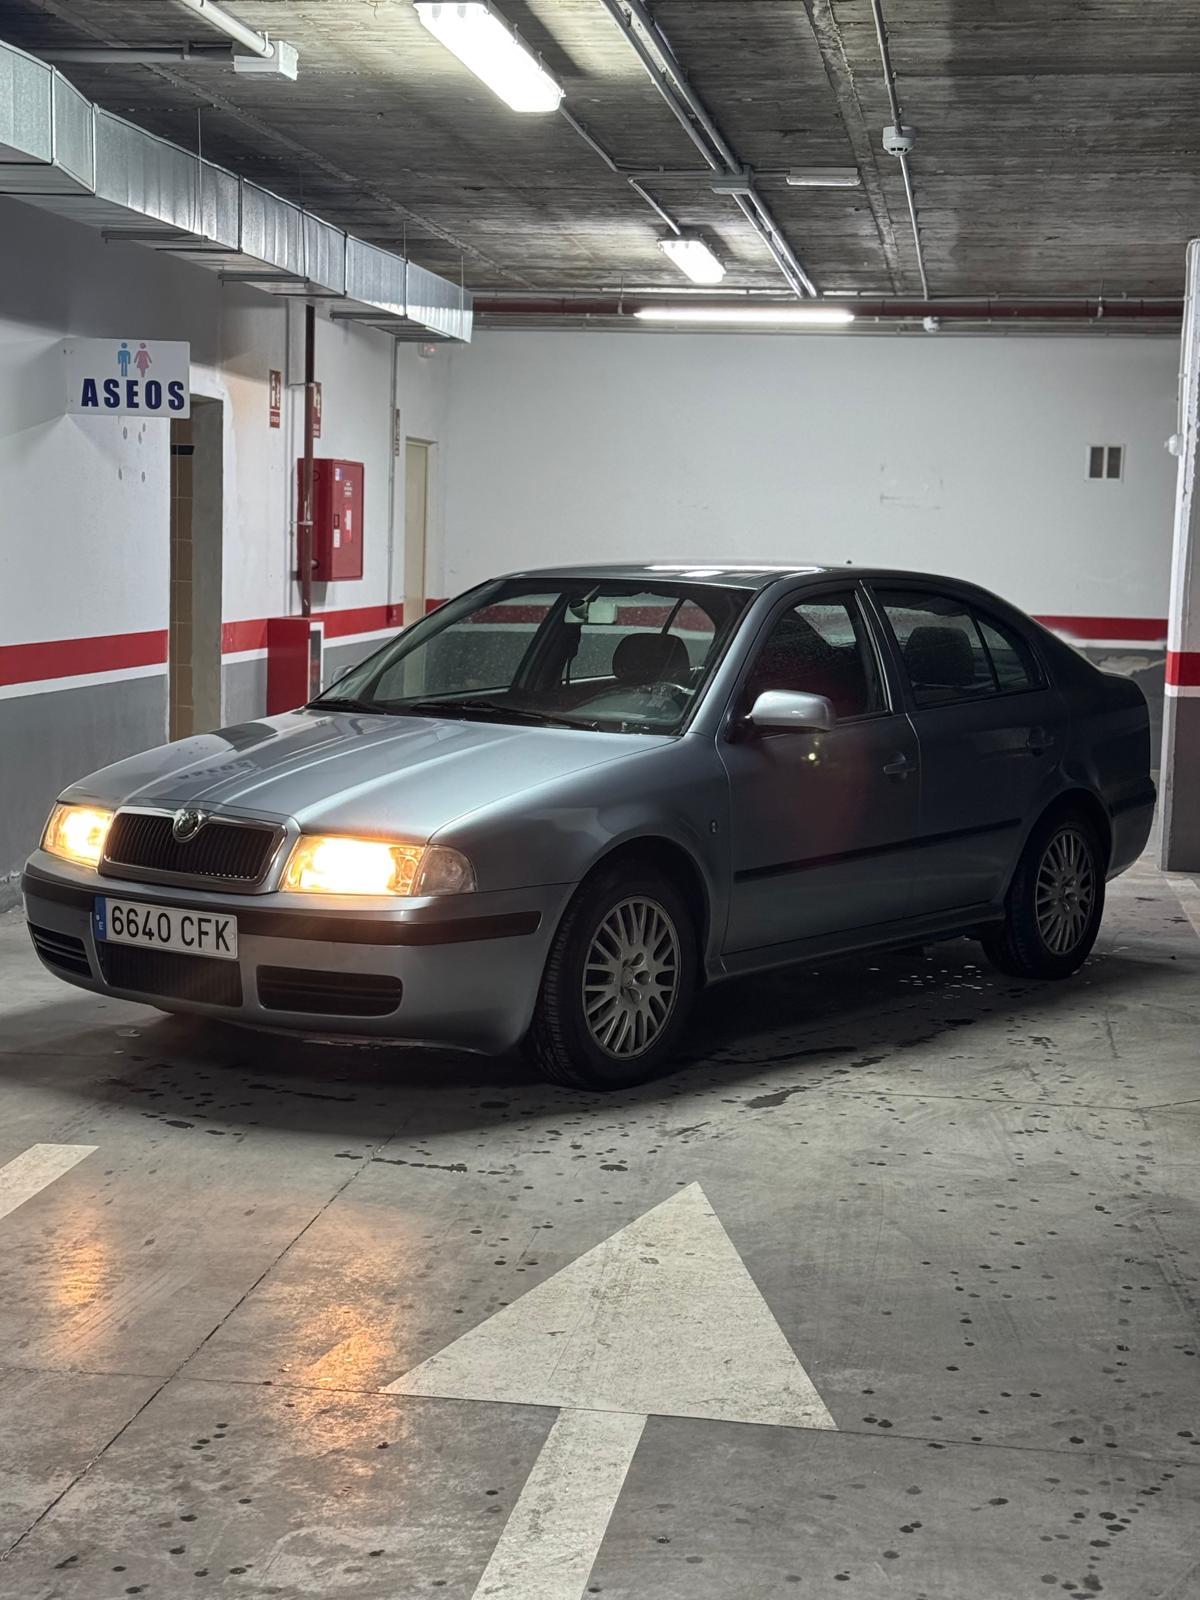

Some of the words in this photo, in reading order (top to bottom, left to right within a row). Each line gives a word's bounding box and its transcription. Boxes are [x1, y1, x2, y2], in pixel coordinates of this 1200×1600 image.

[81, 378, 185, 411] ASEOS
[111, 905, 171, 943] 6640
[181, 915, 230, 952] CFK
